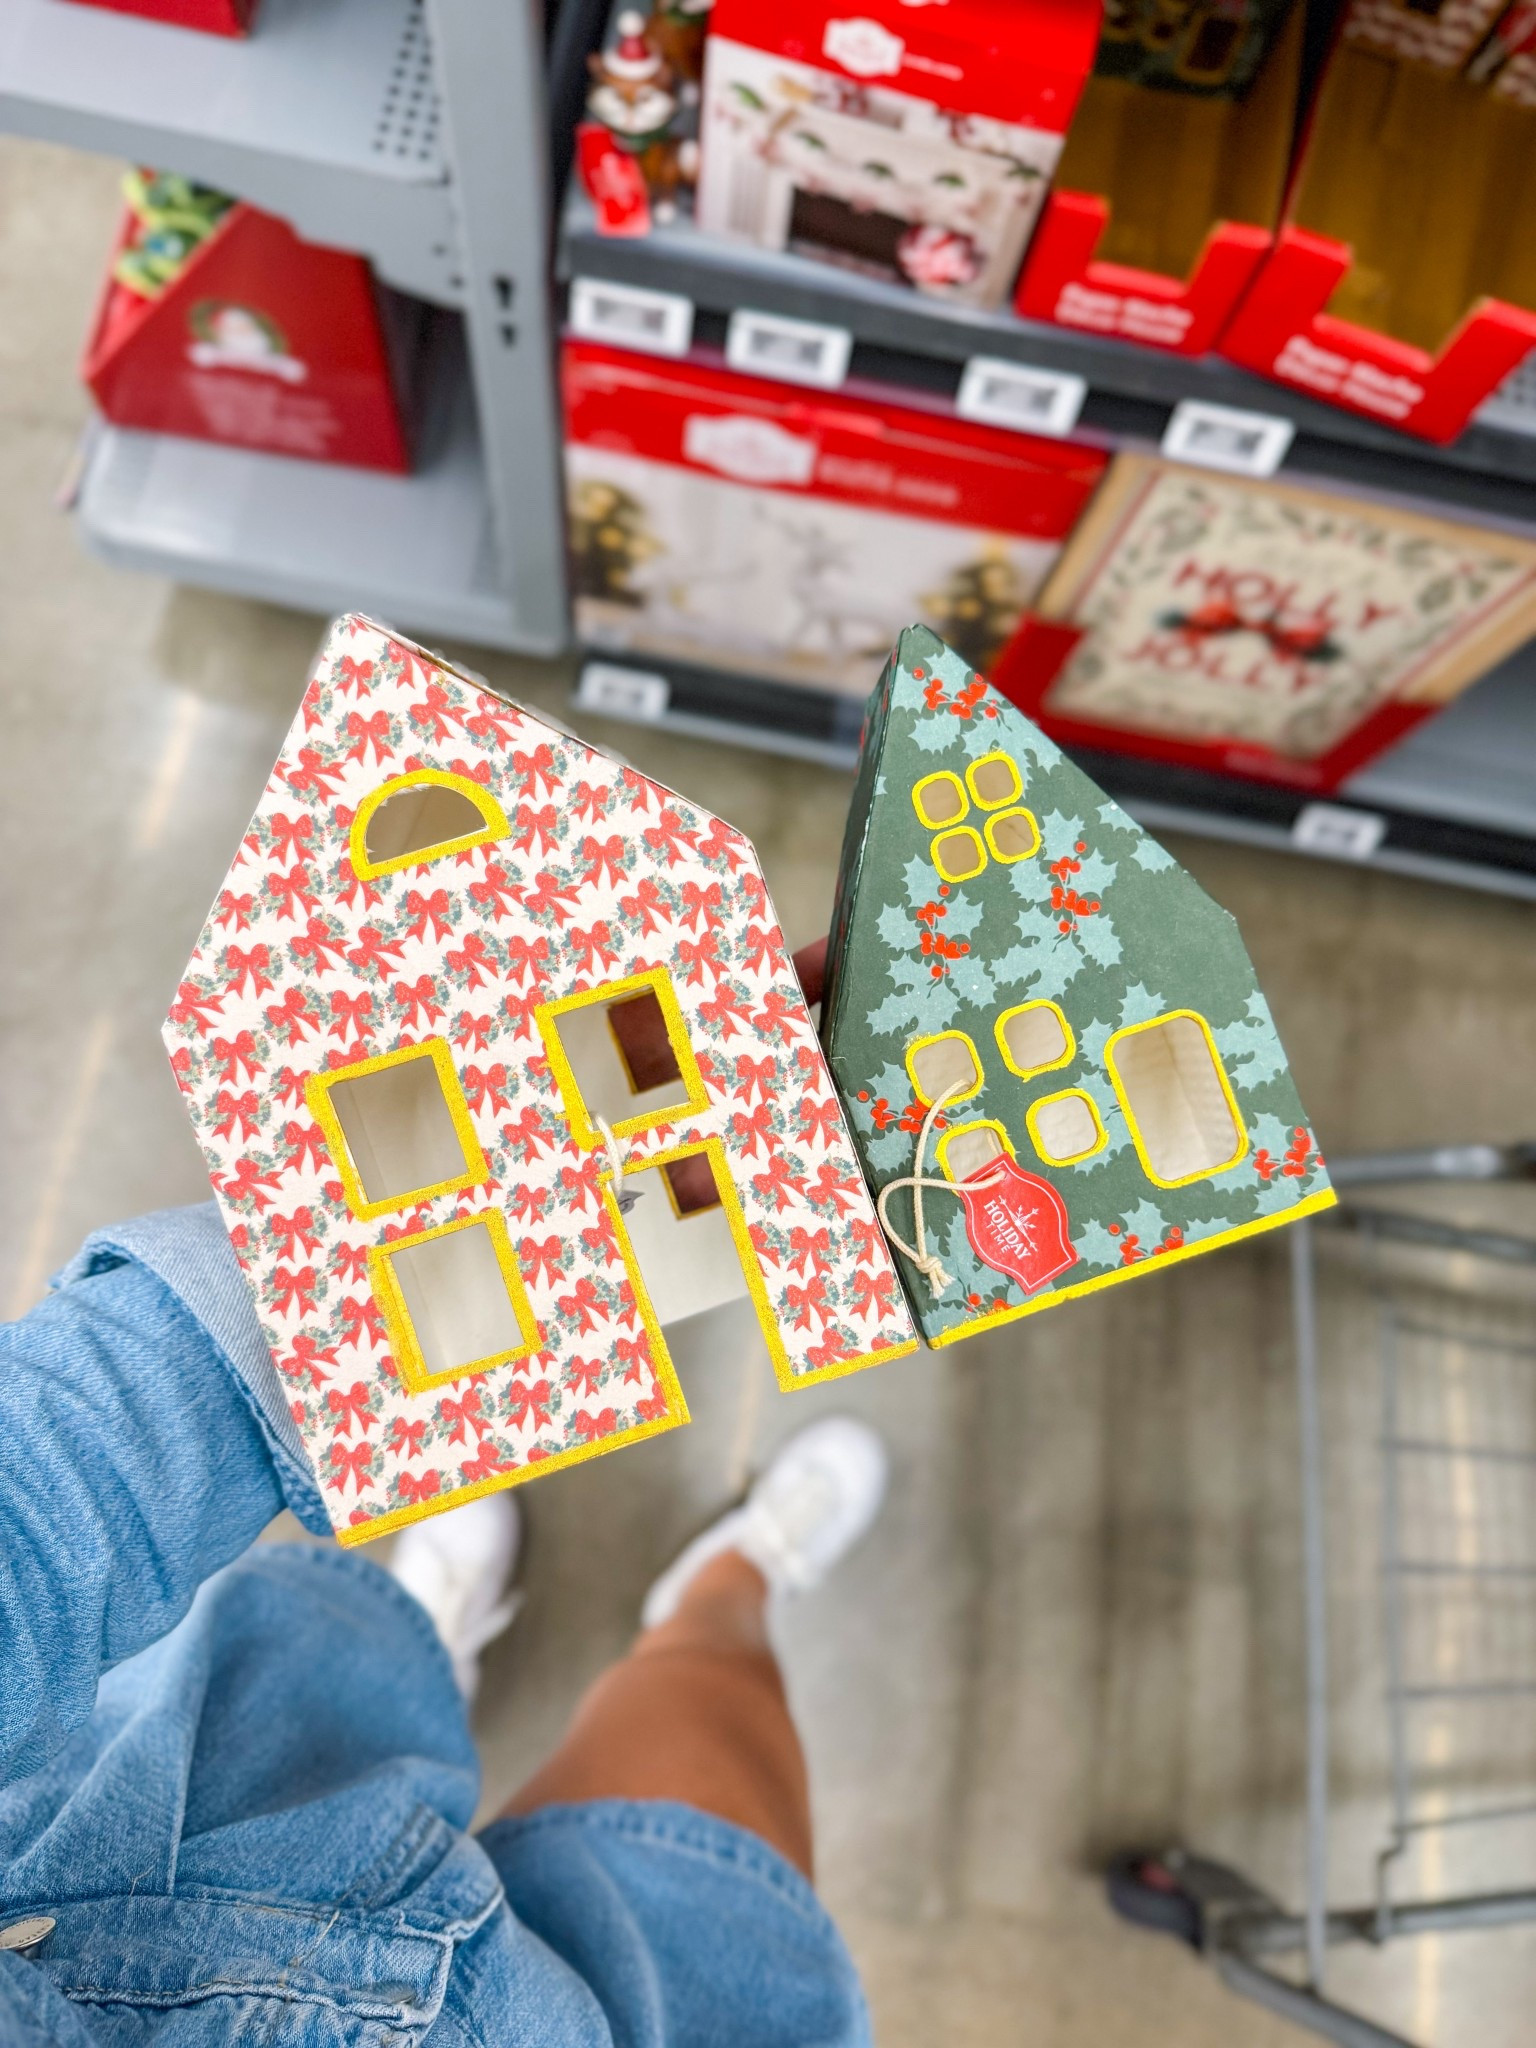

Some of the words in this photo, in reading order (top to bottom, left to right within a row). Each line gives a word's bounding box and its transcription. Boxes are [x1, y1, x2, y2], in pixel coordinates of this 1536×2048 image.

[1174, 559, 1400, 632] HOLLY
[984, 1200, 1031, 1259] HOLIDAY
[986, 1221, 1010, 1253] TIME
